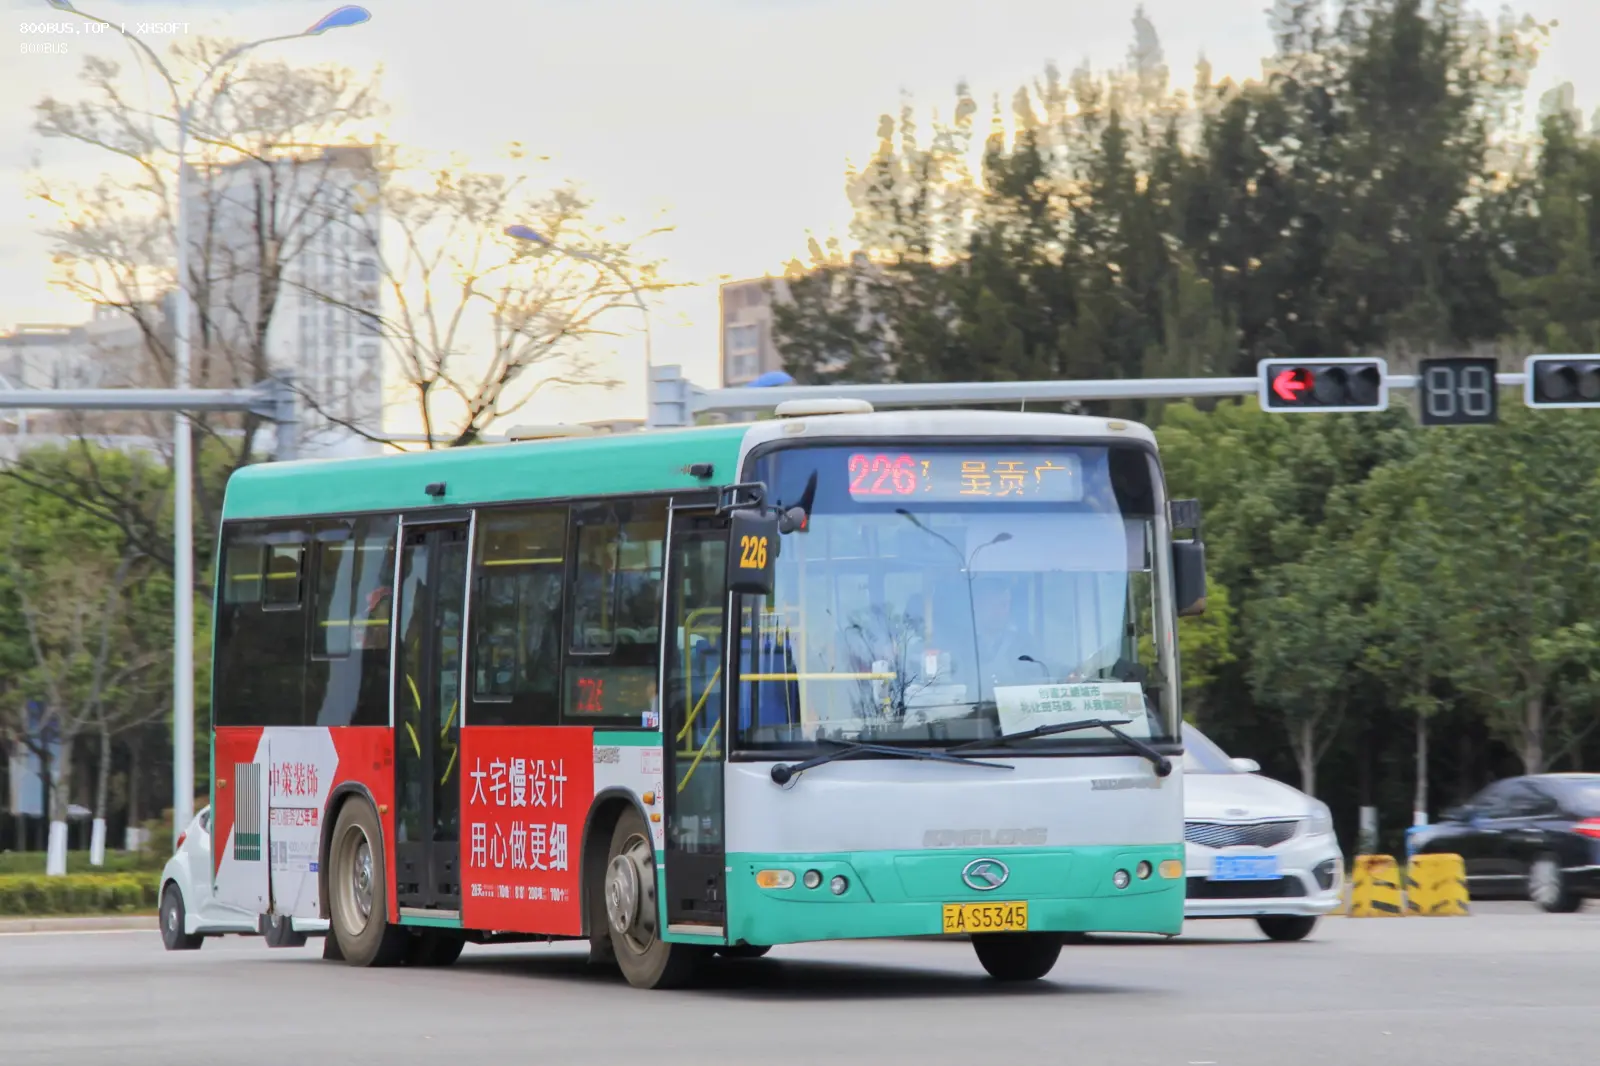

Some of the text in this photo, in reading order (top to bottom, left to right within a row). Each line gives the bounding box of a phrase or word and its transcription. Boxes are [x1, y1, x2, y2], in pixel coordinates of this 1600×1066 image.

[848, 454, 916, 495] 226
[740, 535, 768, 569] 226
[469, 756, 568, 809] 大宅慢设计
[469, 820, 568, 872] 用心做更细
